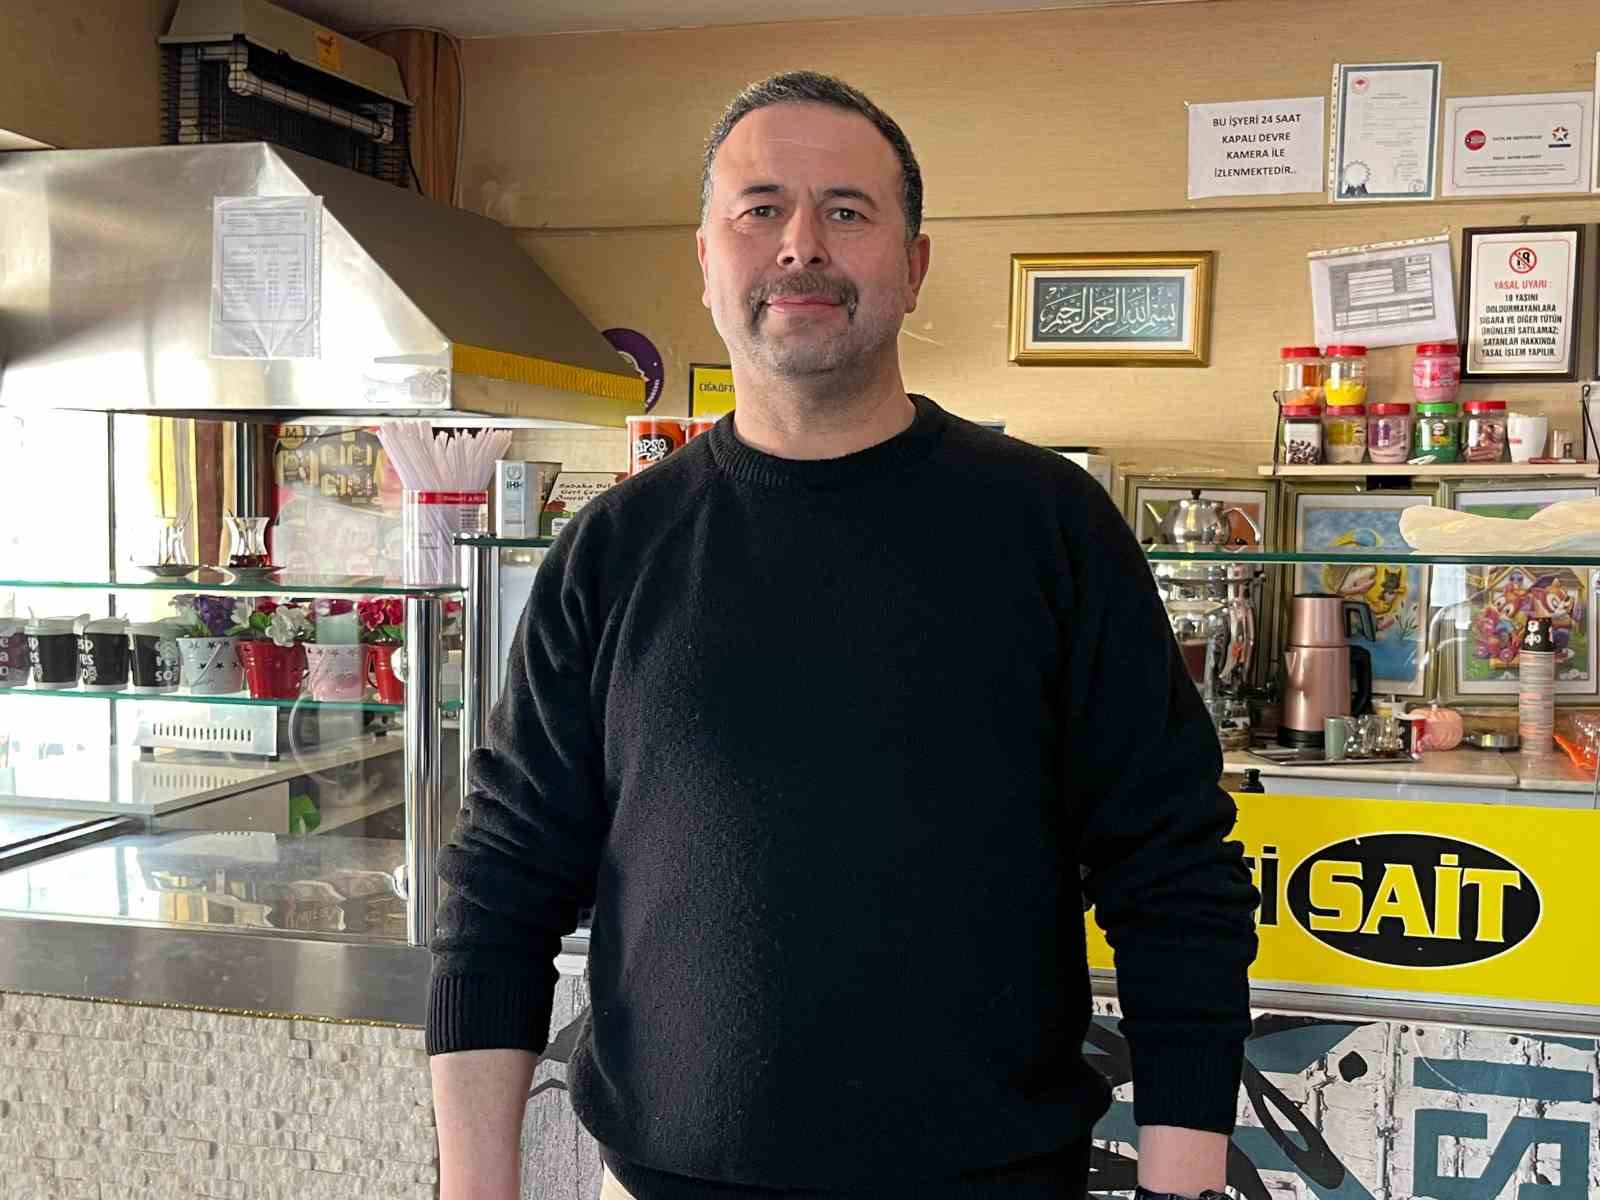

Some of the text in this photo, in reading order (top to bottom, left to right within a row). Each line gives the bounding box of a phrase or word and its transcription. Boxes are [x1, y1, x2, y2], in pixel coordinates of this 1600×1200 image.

[1212, 113, 1301, 128] BU İŞYERİ 24 SAAT
[1222, 132, 1291, 143] KAPALI DEVRE
[1227, 148, 1285, 160] KAMERA İLE
[1494, 280, 1519, 289] YASAL
[1522, 279, 1547, 289] UYARI
[1485, 303, 1557, 313] DOLDURMAYANLARA
[1507, 315, 1515, 323] VE
[1540, 313, 1562, 324] TÜTÜN
[1481, 326, 1516, 336] ÜRÜNLERİ
[1483, 336, 1556, 346] SATANLAR HAKKINDA
[1481, 348, 1503, 357] YASAL
[1308, 853, 1522, 943] SAİT
